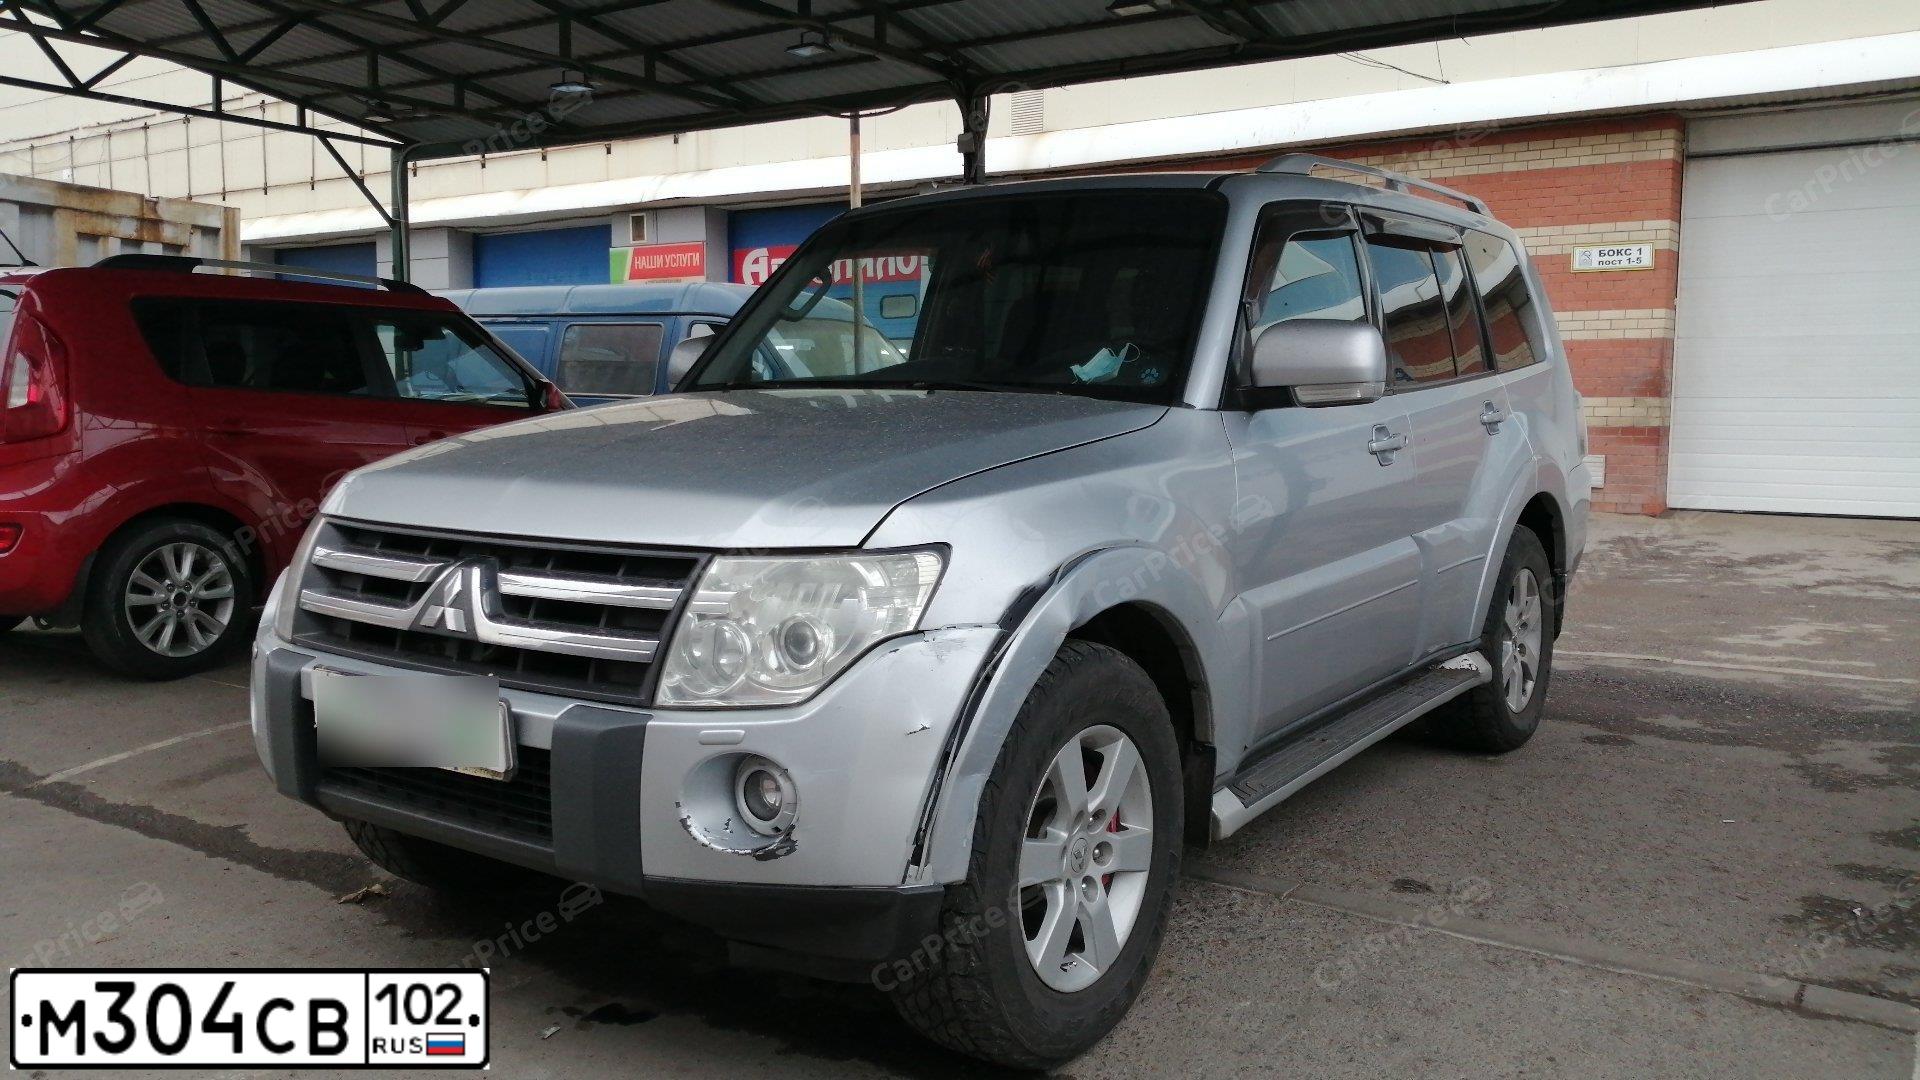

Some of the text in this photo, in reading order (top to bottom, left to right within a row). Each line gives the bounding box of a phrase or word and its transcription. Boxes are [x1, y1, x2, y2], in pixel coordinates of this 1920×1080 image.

[1598, 247, 1643, 258] БОКС 1
[634, 252, 700, 269] НАШИ УСЛУГИ
[1598, 257, 1642, 266] пост 1-5
